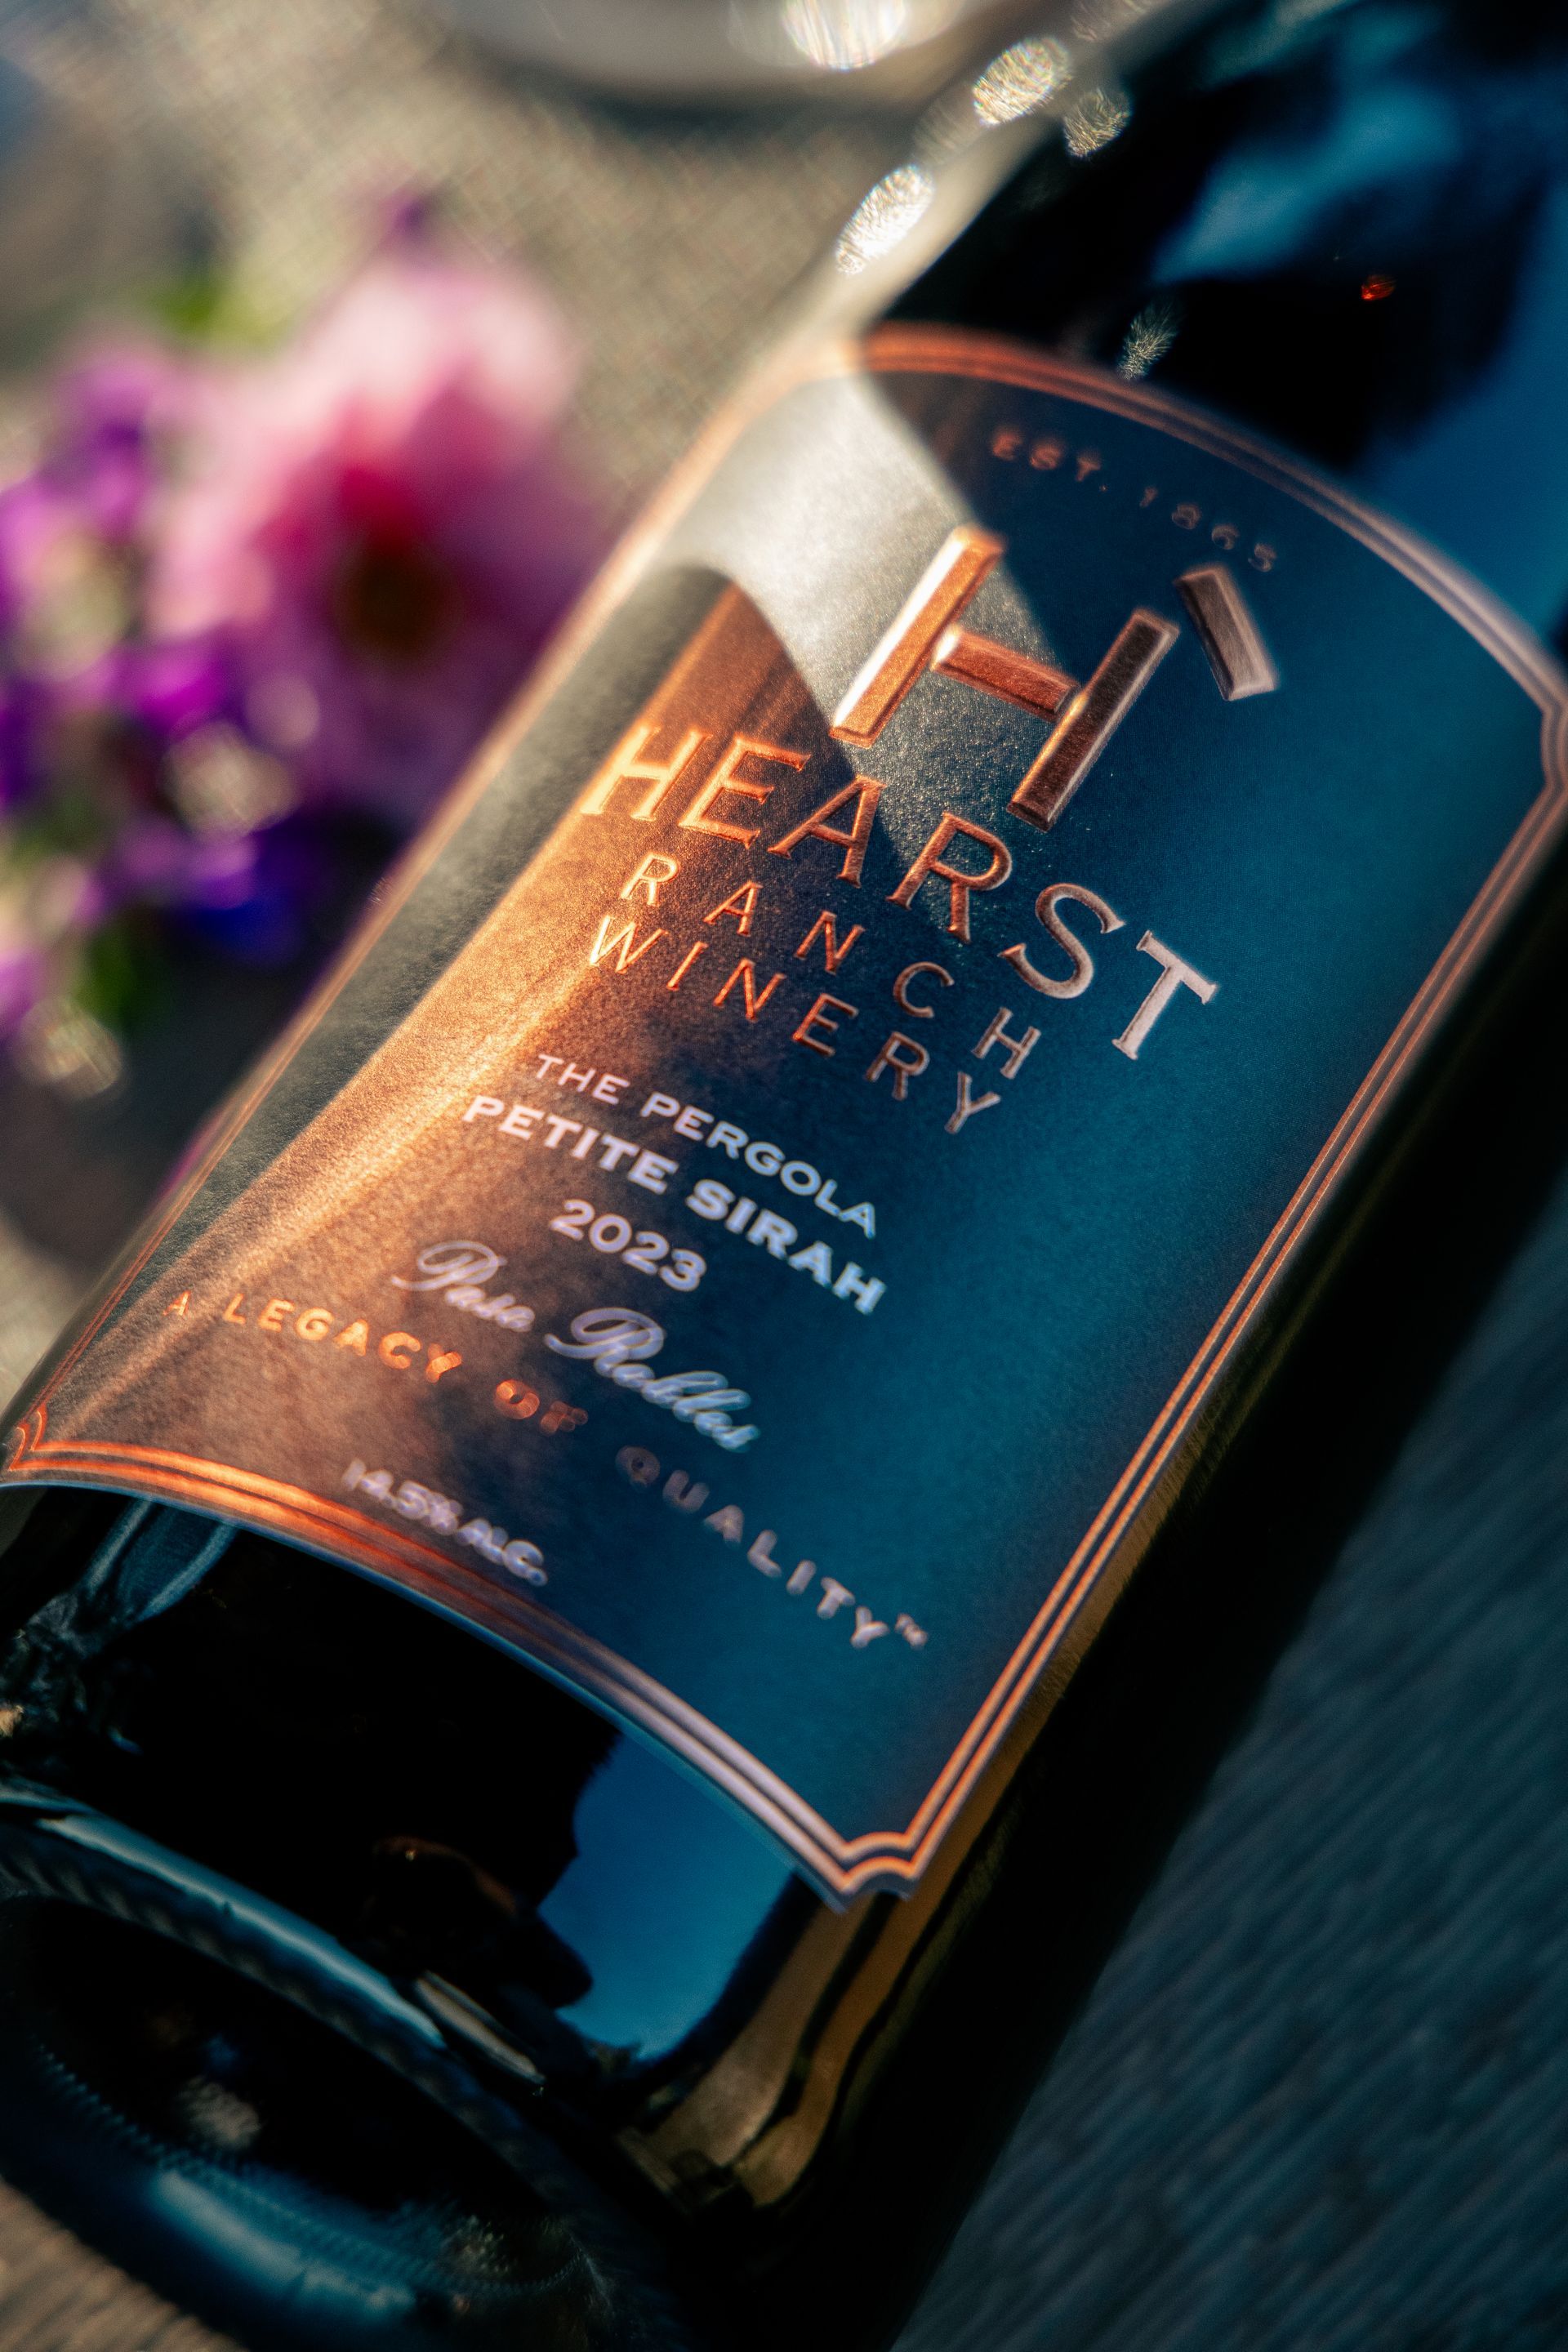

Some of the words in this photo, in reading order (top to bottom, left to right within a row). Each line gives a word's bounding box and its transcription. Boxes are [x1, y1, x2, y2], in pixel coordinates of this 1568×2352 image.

[580, 724, 1220, 1062] HEARST
[619, 851, 1041, 1080] RANCH
[588, 915, 1002, 1135] WINERY
[461, 1094, 679, 1196] PETITE
[684, 1177, 888, 1316] SIRAH
[531, 1052, 631, 1107] THE
[639, 1090, 879, 1241] PERGOLA
[548, 1198, 708, 1294] 2023
[163, 1290, 192, 1317] A
[221, 1292, 463, 1383] LEGACY
